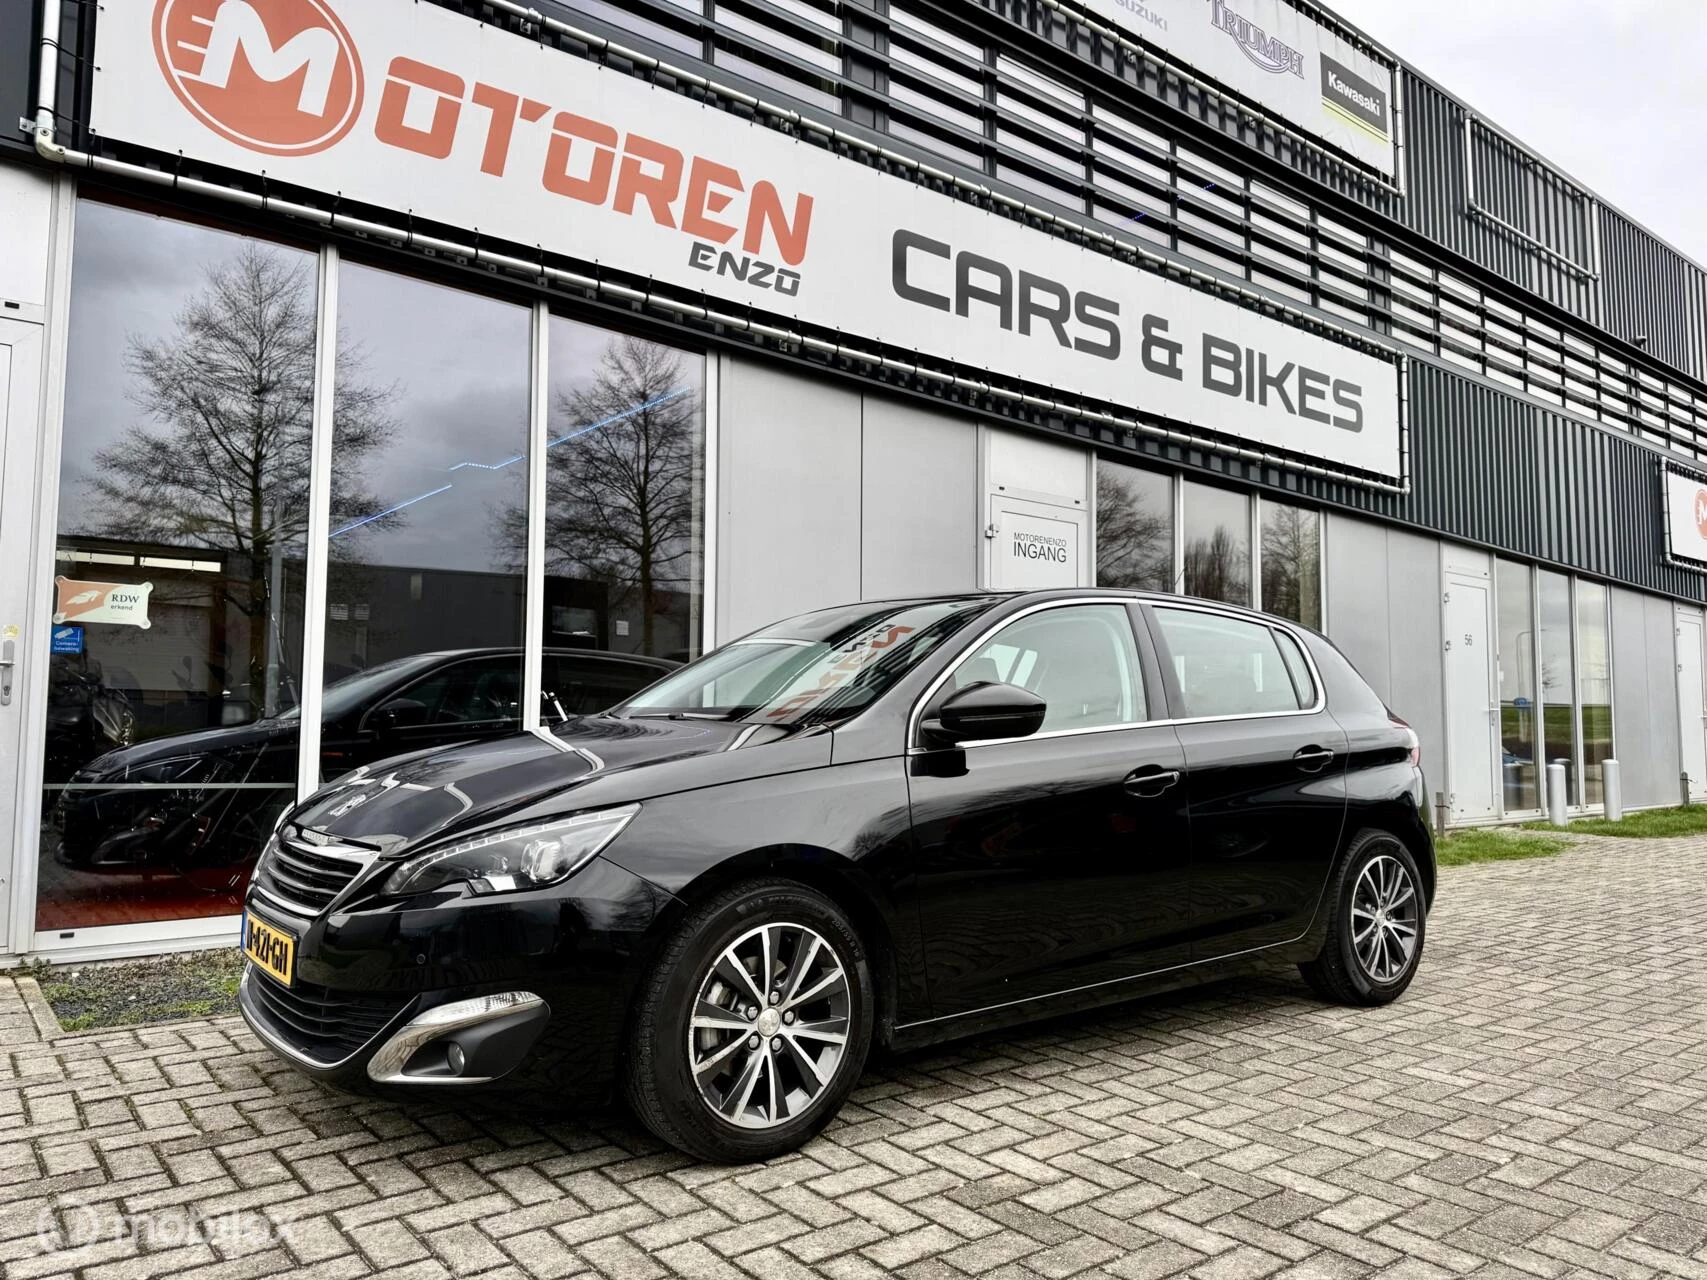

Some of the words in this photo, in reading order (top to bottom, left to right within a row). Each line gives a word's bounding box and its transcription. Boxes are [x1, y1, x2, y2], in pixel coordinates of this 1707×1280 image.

[1327, 70, 1381, 117] Kawasaki
[688, 241, 801, 297] ENZO
[892, 229, 1121, 361] CARS
[1141, 313, 1184, 382] &
[1202, 332, 1365, 434] BIKES
[1013, 532, 1067, 547] MOTORENENZO
[1013, 541, 1067, 563] INGANG
[111, 594, 140, 603] RDW
